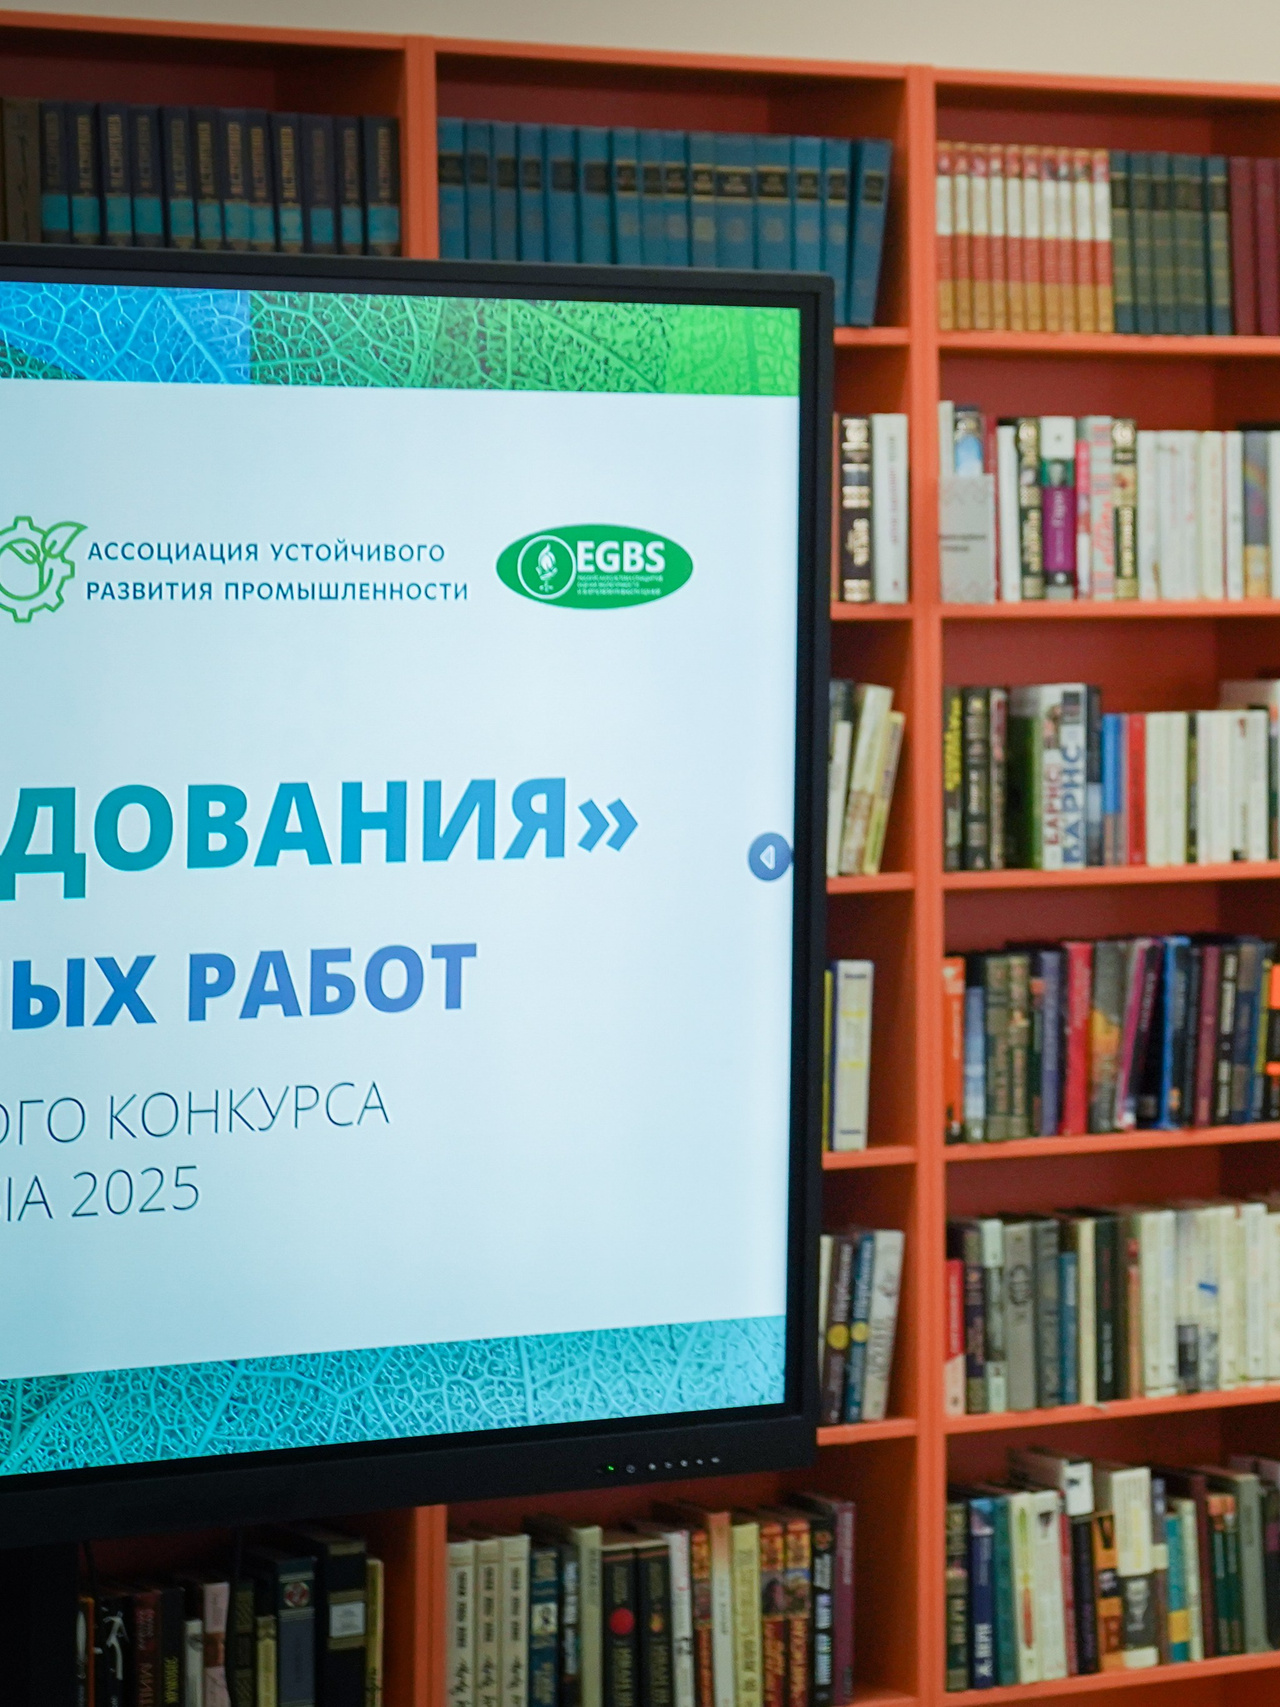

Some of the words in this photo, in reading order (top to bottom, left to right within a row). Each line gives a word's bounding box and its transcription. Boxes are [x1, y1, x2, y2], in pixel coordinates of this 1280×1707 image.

[87, 541, 259, 566] АССОЦИАЦИЯ
[270, 537, 445, 563] УСТОЙЧИВОГО
[576, 540, 666, 573] EGBS
[86, 581, 213, 601] РАЗВИТИЯ
[224, 581, 468, 602] ПРОМЫШЛЕННОСТИ
[0, 777, 639, 900] ДОВАНИЯ»
[12, 955, 157, 1030] ЫХ
[188, 943, 478, 1023] РАБОТ
[0, 1097, 86, 1145] ГО
[109, 1081, 390, 1141] КОНКУРСА
[71, 1165, 200, 1218] 2025
